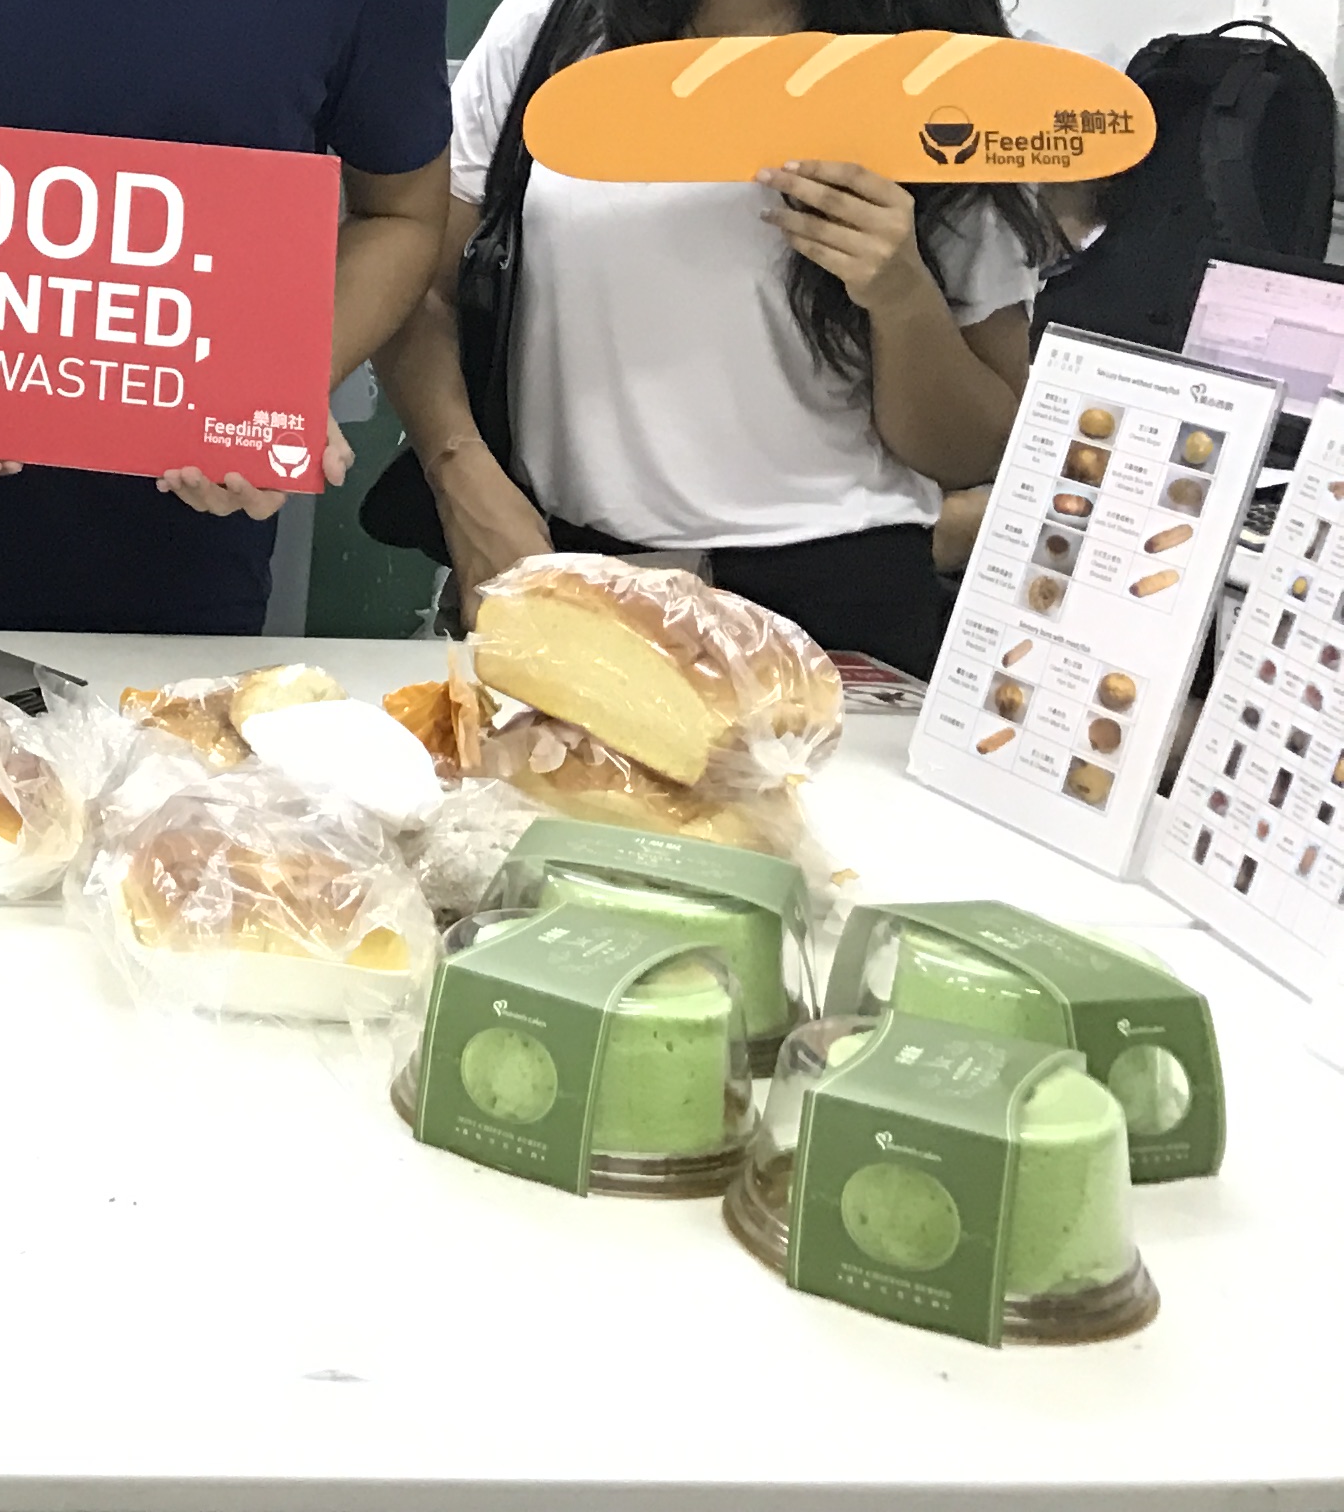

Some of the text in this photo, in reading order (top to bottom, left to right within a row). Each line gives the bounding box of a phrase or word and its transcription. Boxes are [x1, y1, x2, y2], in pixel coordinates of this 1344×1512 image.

[1053, 107, 1135, 136] 樂餉社
[983, 129, 1084, 157] Feeding
[985, 151, 1072, 170] Hong Kong
[203, 416, 273, 444] Feeding
[252, 409, 305, 432] 樂餉社
[203, 432, 264, 451] Hong Kong
